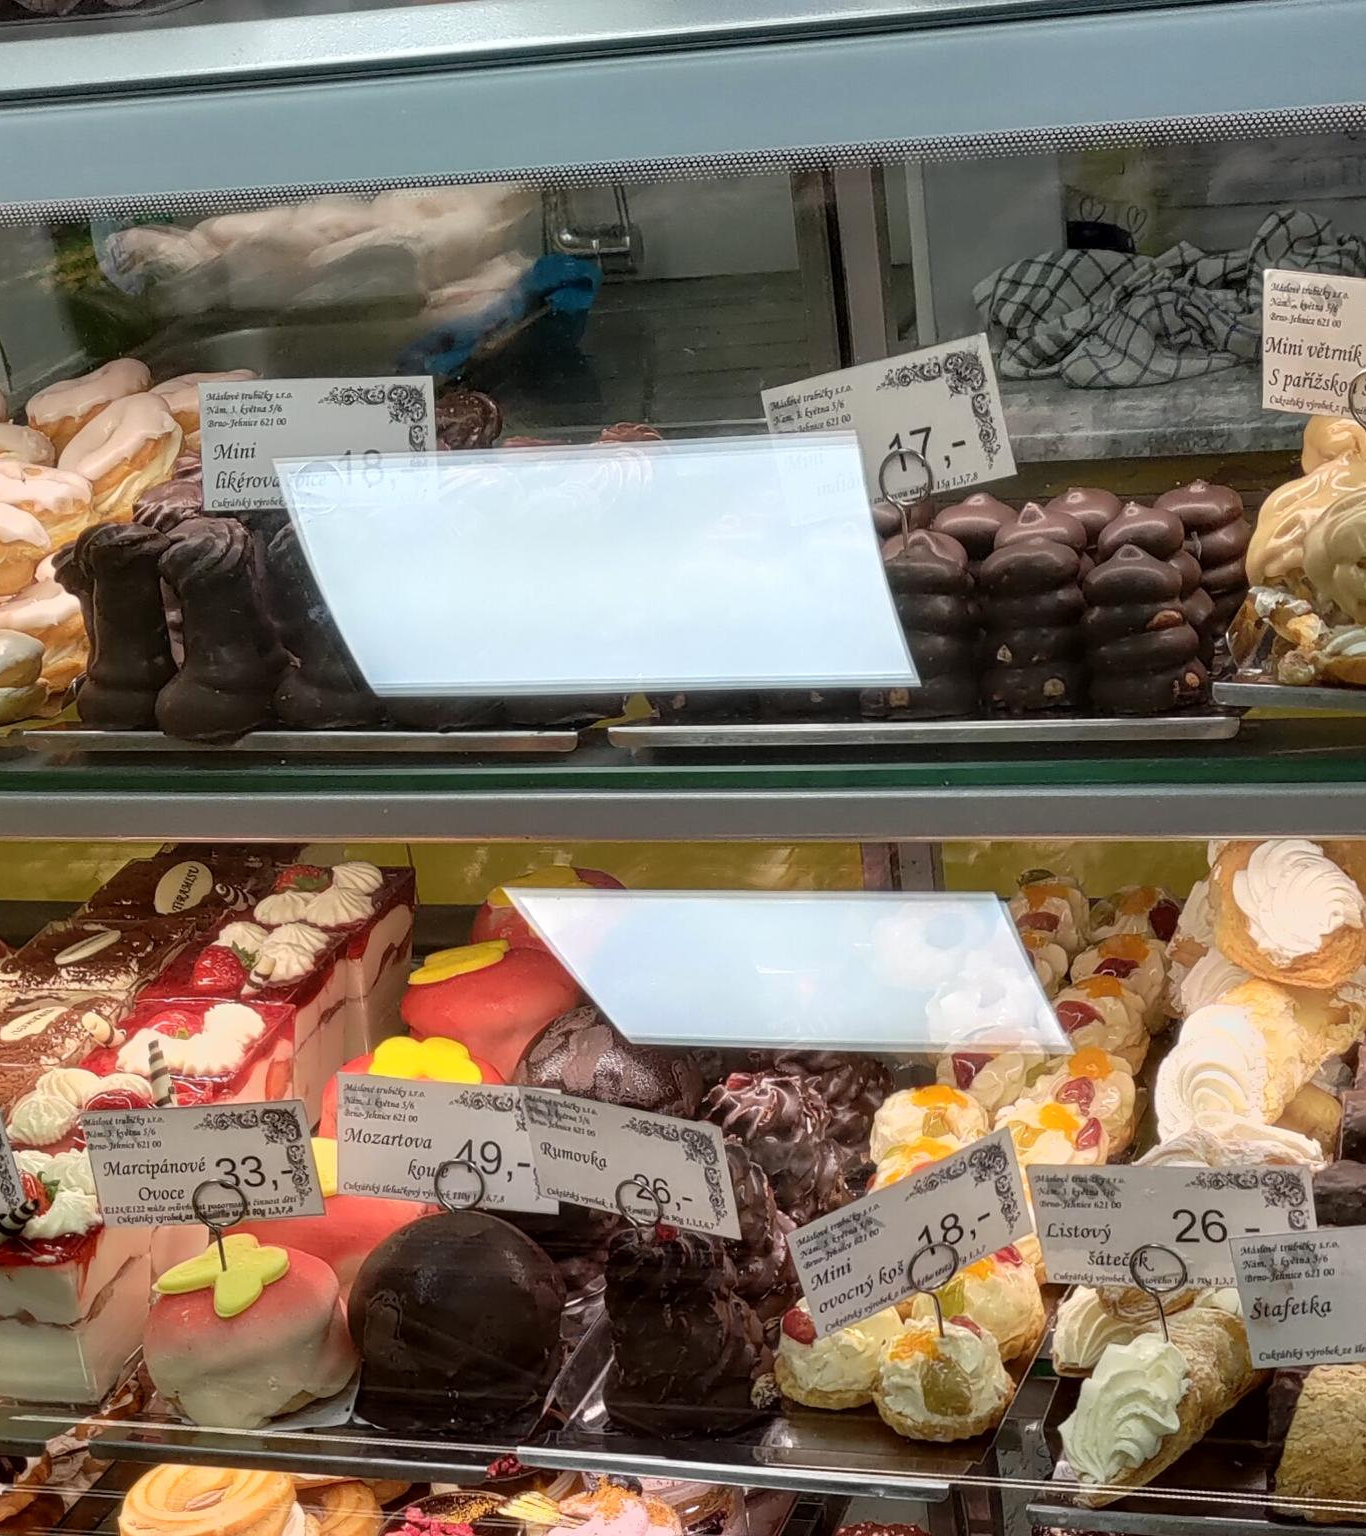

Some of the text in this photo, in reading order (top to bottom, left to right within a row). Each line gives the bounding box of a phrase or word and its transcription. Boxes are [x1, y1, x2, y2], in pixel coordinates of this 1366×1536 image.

[1266, 336, 1304, 355] Mini
[1307, 343, 1366, 369] větrník
[1269, 369, 1279, 386] S
[241, 389, 273, 402] trubičky
[240, 404, 283, 416] května 5/6
[260, 417, 274, 427] 621
[276, 417, 287, 426] 00
[213, 442, 256, 460] Mini
[888, 426, 966, 472] 17,-
[345, 1127, 530, 1182] Mozartova 49,-
[540, 1141, 607, 1171] Rumovka
[104, 1155, 293, 1191] Marcipánové 33,-
[139, 1186, 185, 1201] Ovoce
[634, 1173, 693, 1211] 26,-
[1045, 1222, 1112, 1244] Listový
[811, 1257, 852, 1291] Mini
[918, 1212, 991, 1255] 18,-
[1279, 1241, 1339, 1255] trubičky s.r.o.
[819, 1260, 904, 1314] ovocný koš
[1245, 1267, 1335, 1284] Brno-Jehnice 621 00
[1250, 1295, 1332, 1323] Štafetka
